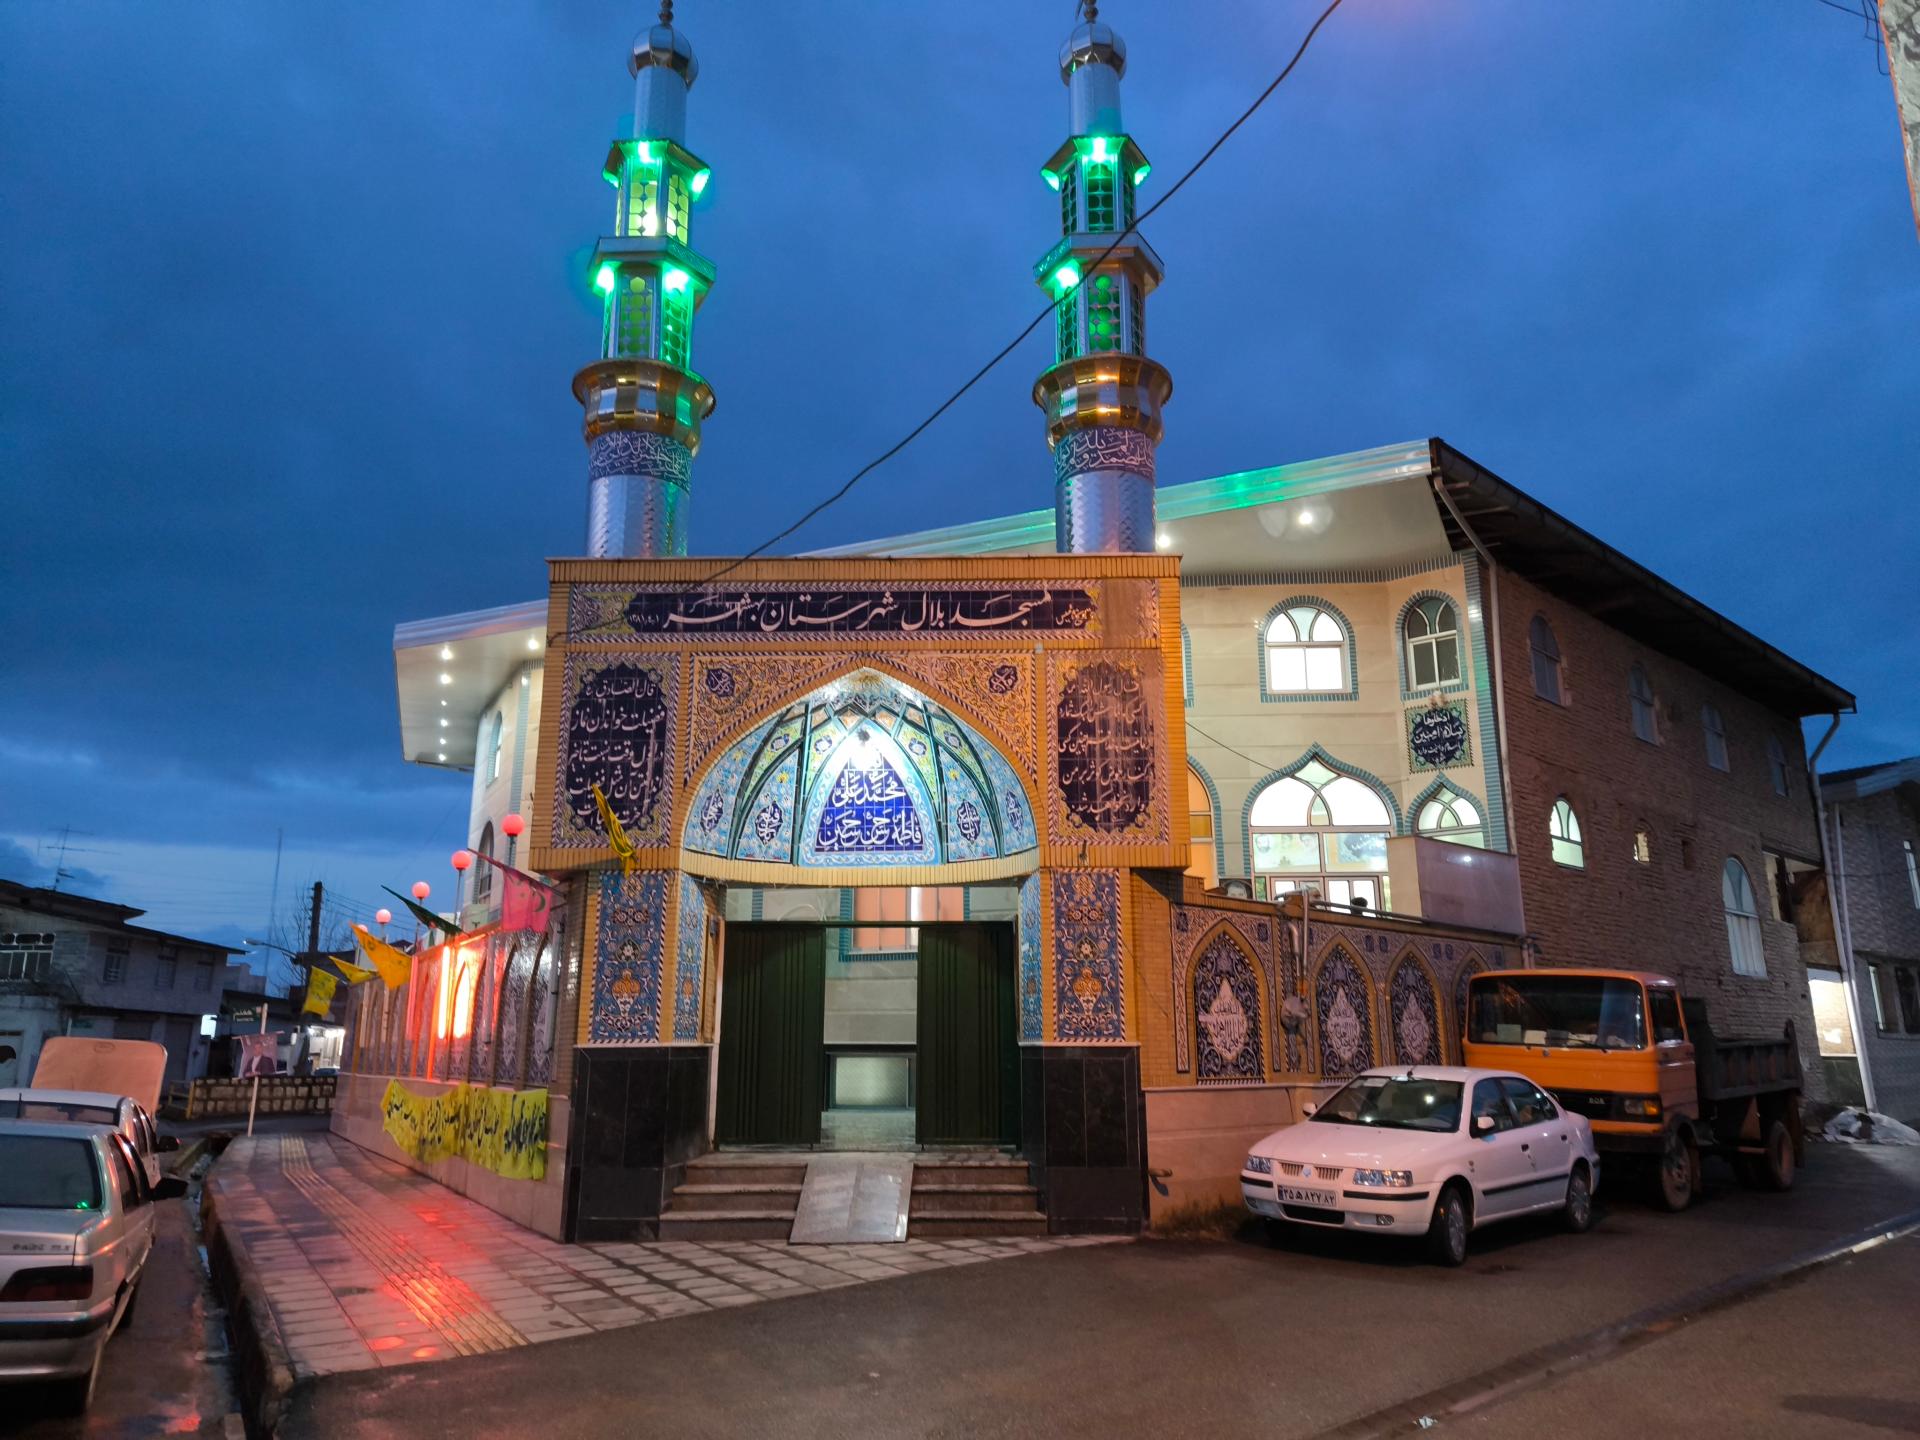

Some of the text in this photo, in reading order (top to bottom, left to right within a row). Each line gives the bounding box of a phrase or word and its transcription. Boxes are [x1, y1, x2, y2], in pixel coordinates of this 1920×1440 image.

[662, 592, 765, 630] بهشهر
[760, 591, 899, 632] شهرستان
[900, 591, 946, 632] بلال
[948, 586, 1052, 628] مسجد
[570, 705, 666, 734] فضیلت خواندن نماز
[583, 741, 610, 763] نسبت
[607, 741, 634, 762] وقت
[1062, 766, 1079, 785] من
